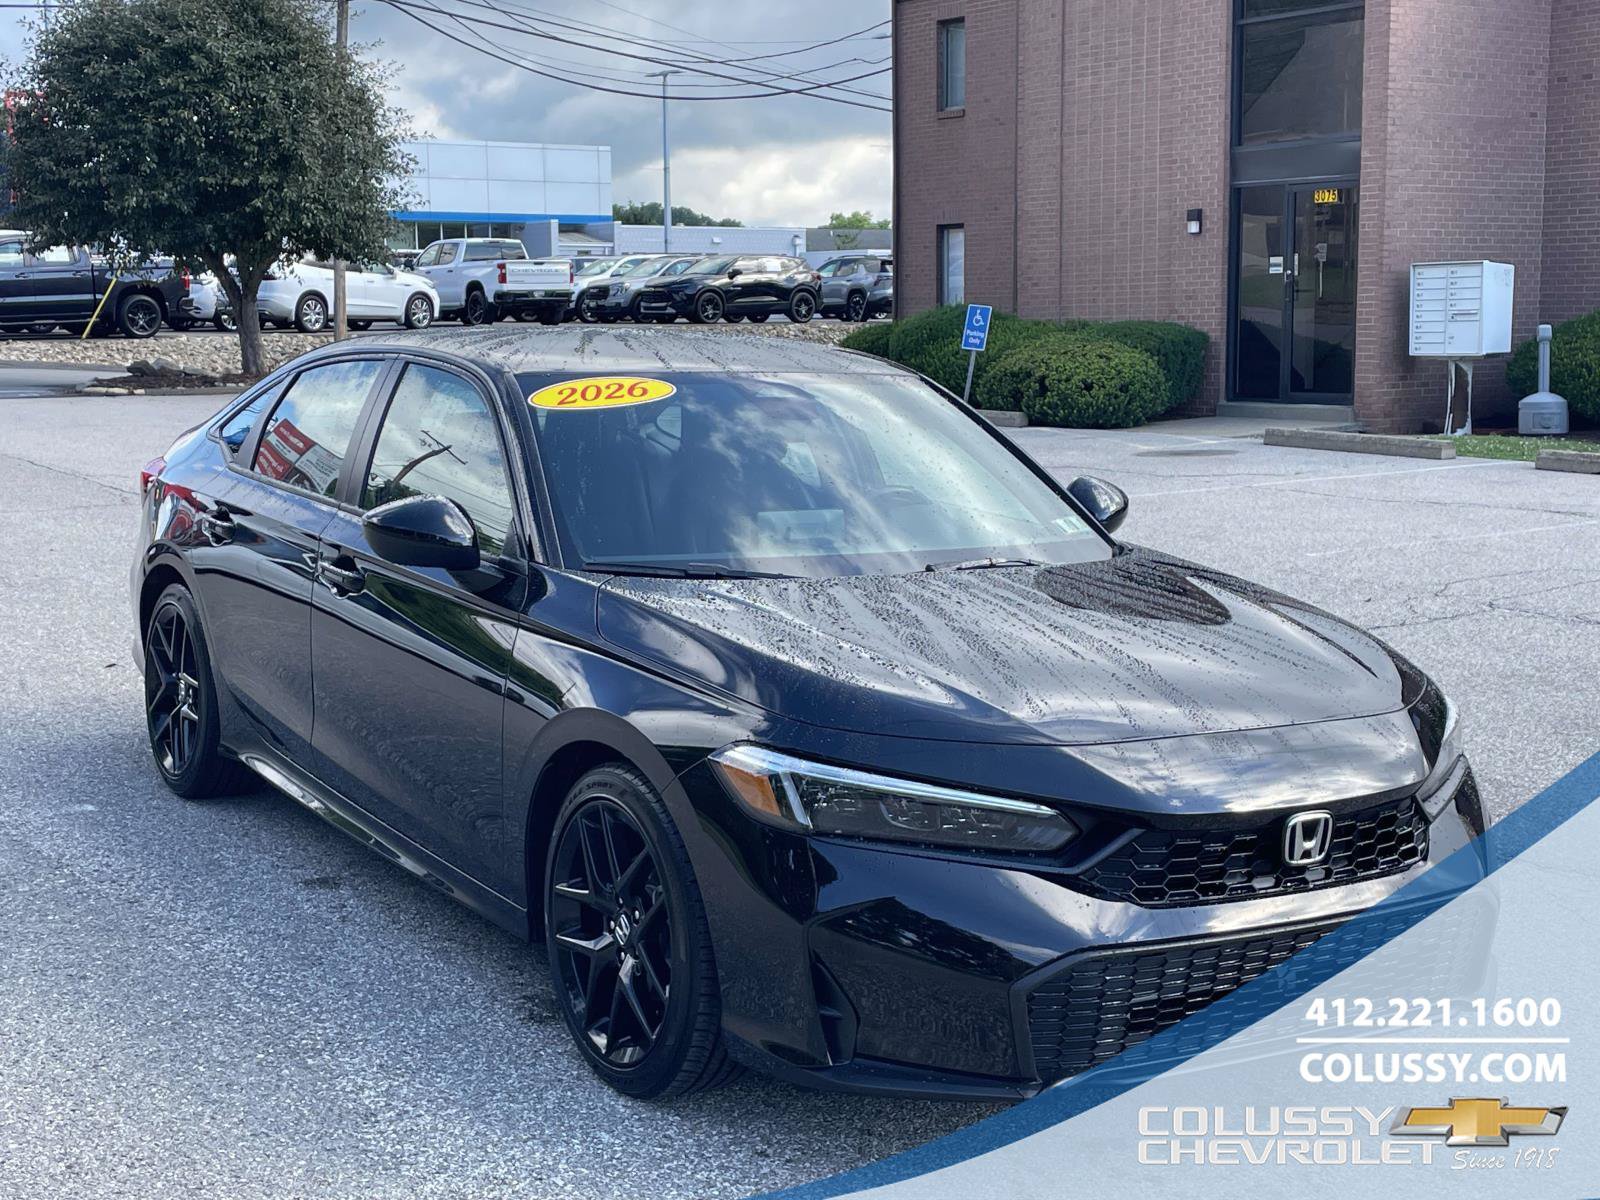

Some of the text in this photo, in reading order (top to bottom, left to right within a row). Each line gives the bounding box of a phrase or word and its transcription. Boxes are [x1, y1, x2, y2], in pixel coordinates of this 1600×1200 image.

[1314, 189, 1337, 202] 3075
[966, 329, 985, 338] Parking
[968, 336, 981, 345] Only
[557, 381, 649, 405] 2026
